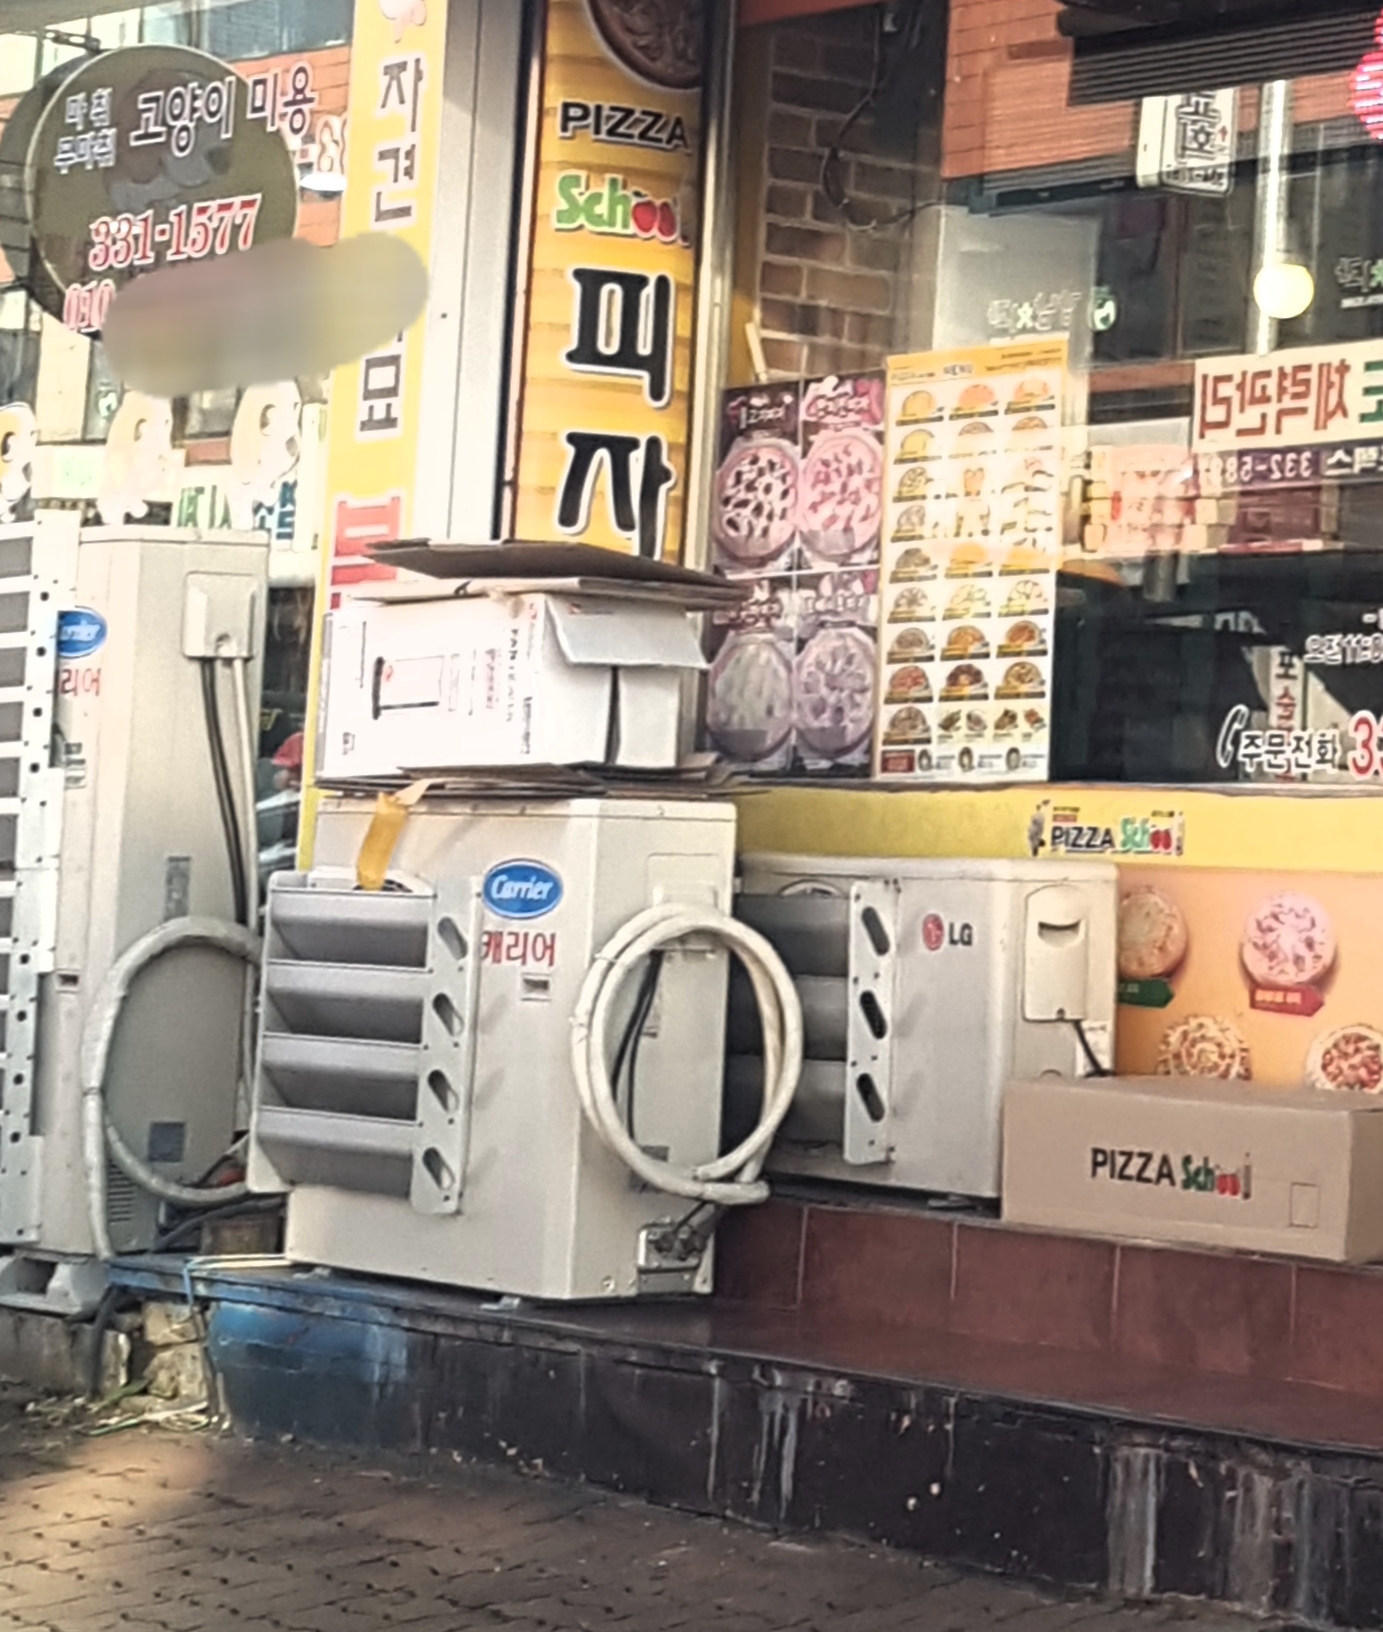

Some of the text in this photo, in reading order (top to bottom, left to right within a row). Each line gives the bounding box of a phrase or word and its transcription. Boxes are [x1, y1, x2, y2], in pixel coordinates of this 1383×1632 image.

[130, 75, 237, 158] 고양이
[247, 61, 319, 138] 미용
[559, 101, 692, 153] PIZZA
[88, 193, 263, 271] 331-1577
[557, 267, 677, 561] 피자
[1237, 726, 1343, 775] 주문전화
[1051, 825, 1116, 849] PIZZA
[490, 872, 556, 908] Carrier
[948, 923, 973, 948] LG
[1090, 1147, 1176, 1187] PIZZA
